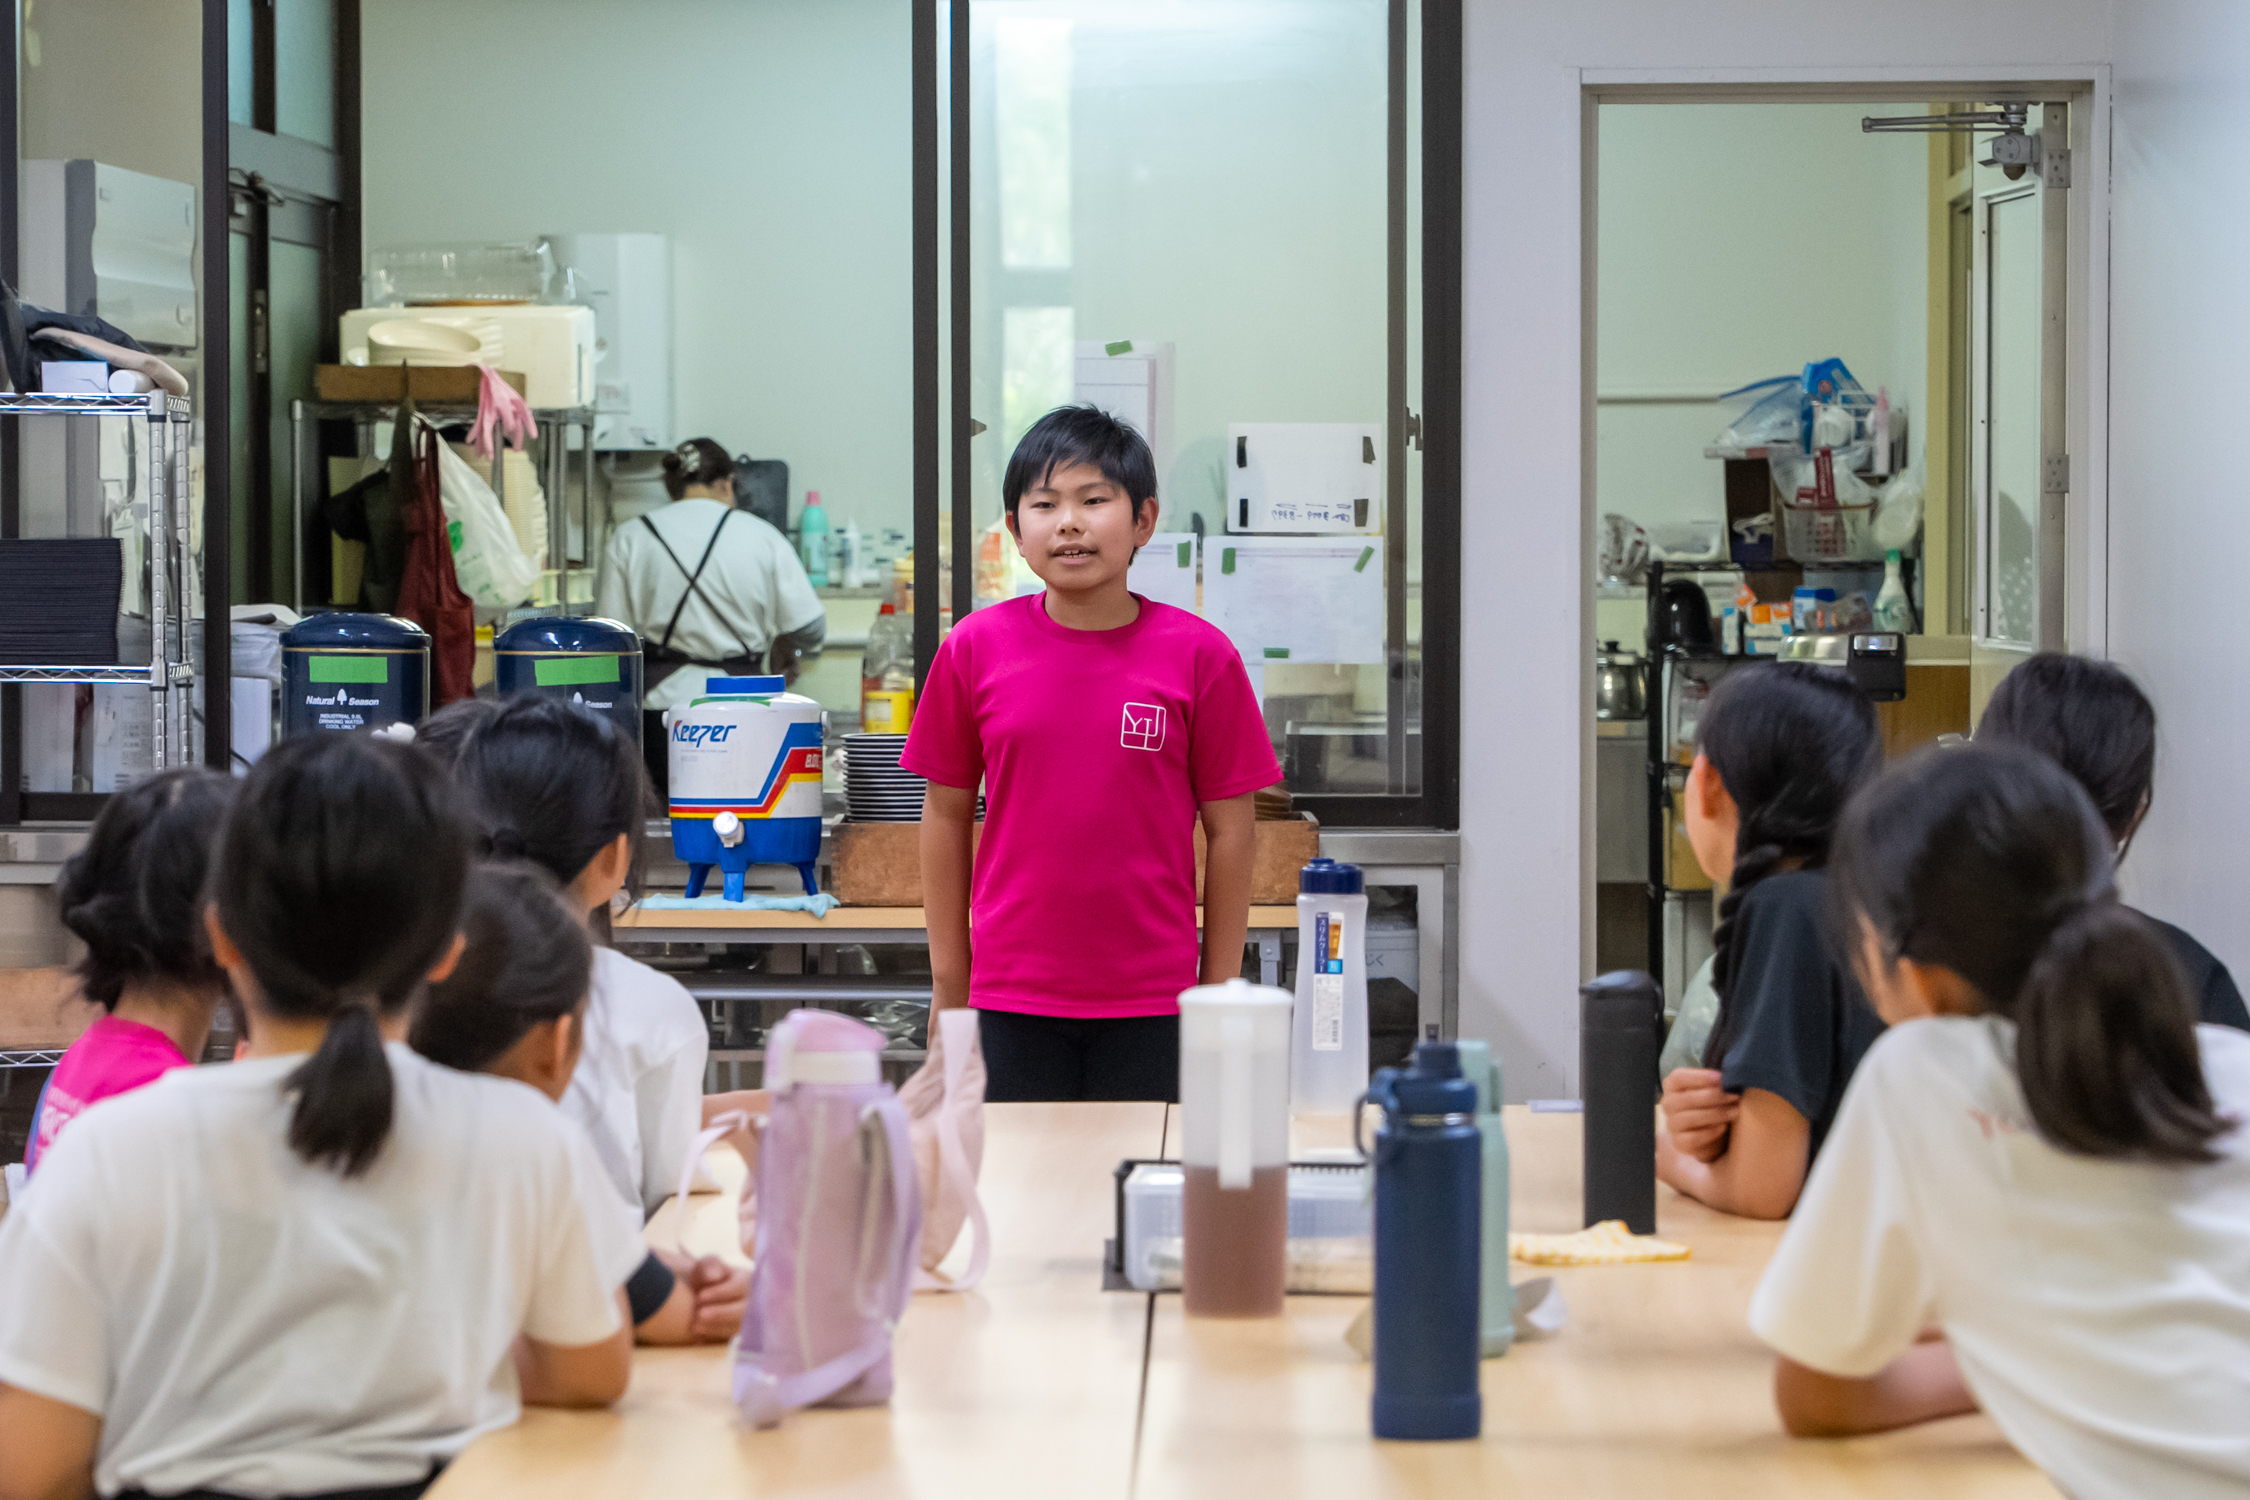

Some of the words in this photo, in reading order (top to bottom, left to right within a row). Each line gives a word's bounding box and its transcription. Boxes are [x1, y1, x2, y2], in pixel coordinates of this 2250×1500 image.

[306, 695, 335, 705] Natural
[348, 697, 380, 706] Season
[585, 700, 613, 709] Season
[672, 719, 737, 748] Keeper
